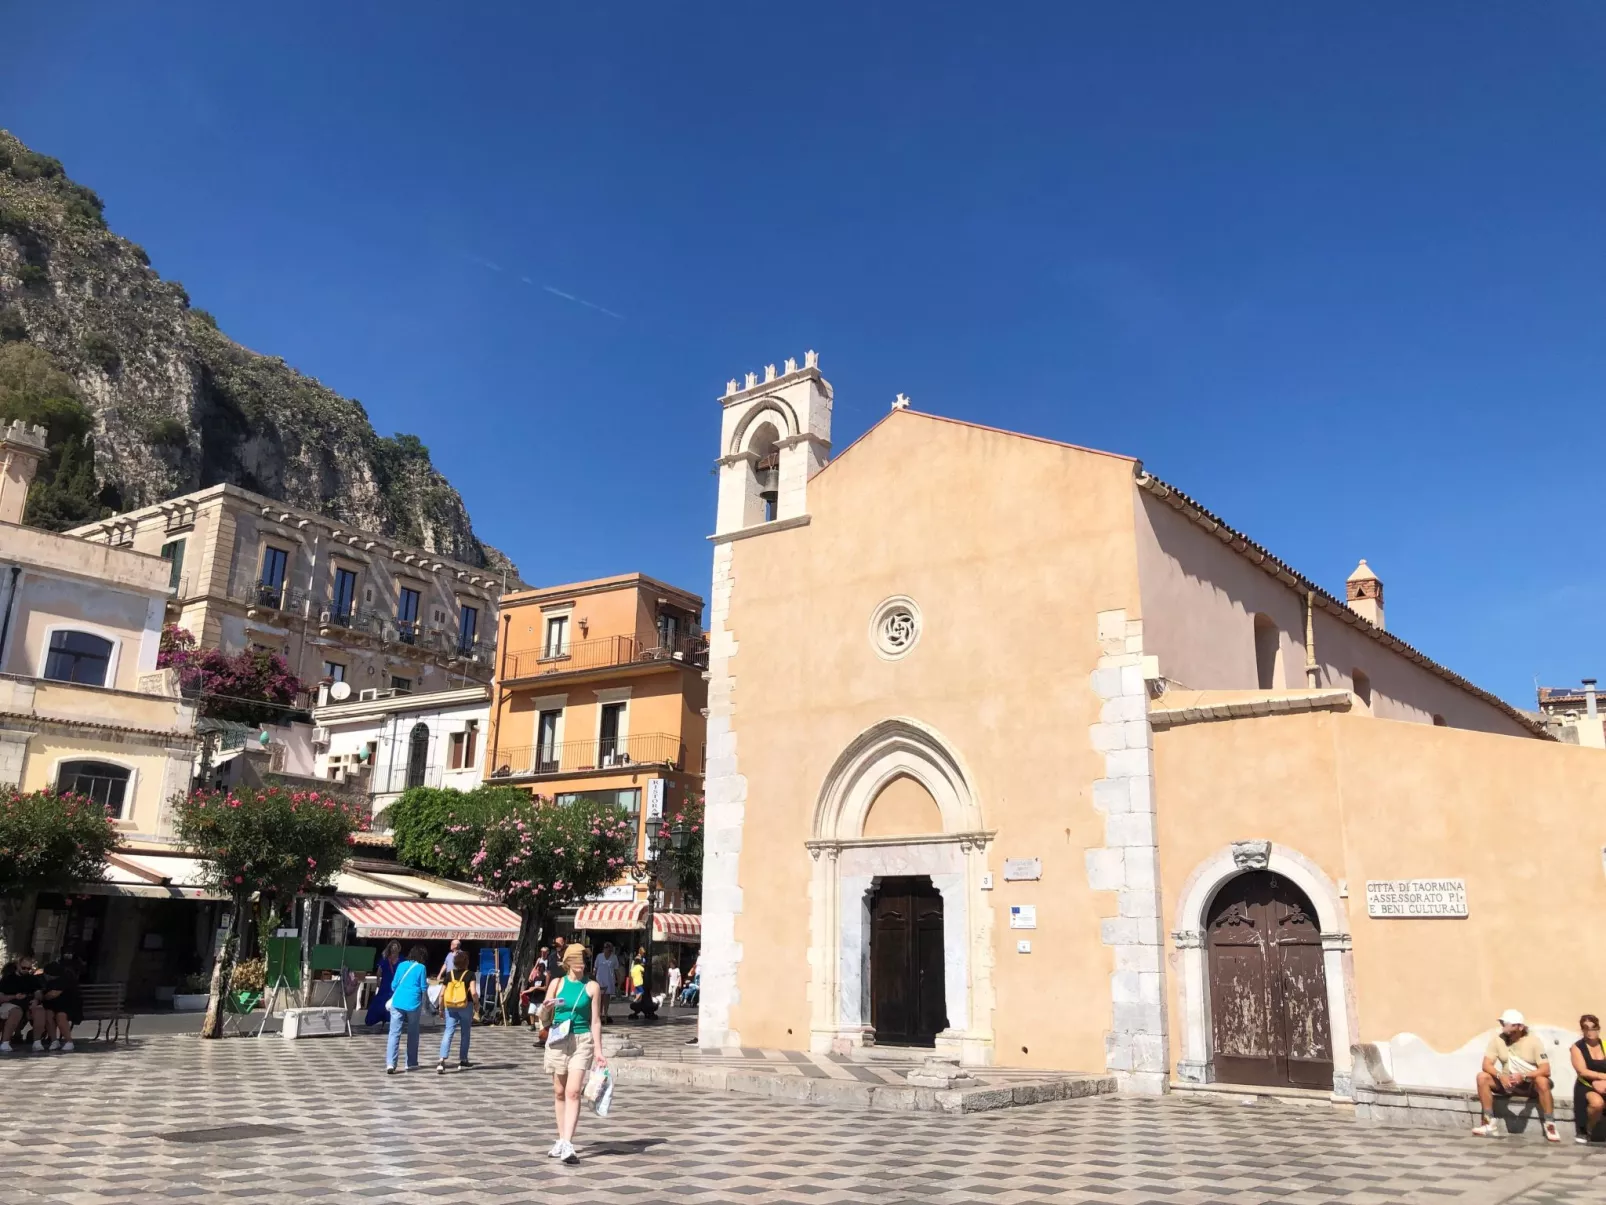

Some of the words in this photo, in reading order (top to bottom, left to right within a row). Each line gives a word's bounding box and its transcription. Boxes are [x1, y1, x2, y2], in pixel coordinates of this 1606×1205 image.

[1398, 882, 1410, 892] DI
[1411, 881, 1465, 892] TAORMINA
[1369, 905, 1376, 914] E
[1381, 904, 1404, 914] BENI
[1408, 903, 1467, 914] CULTURALI
[369, 927, 405, 937] SICILIAN
[407, 928, 428, 938] FOOD
[430, 929, 448, 938] NON
[451, 930, 470, 939] STOP
[473, 931, 516, 940] RISTORANTE
